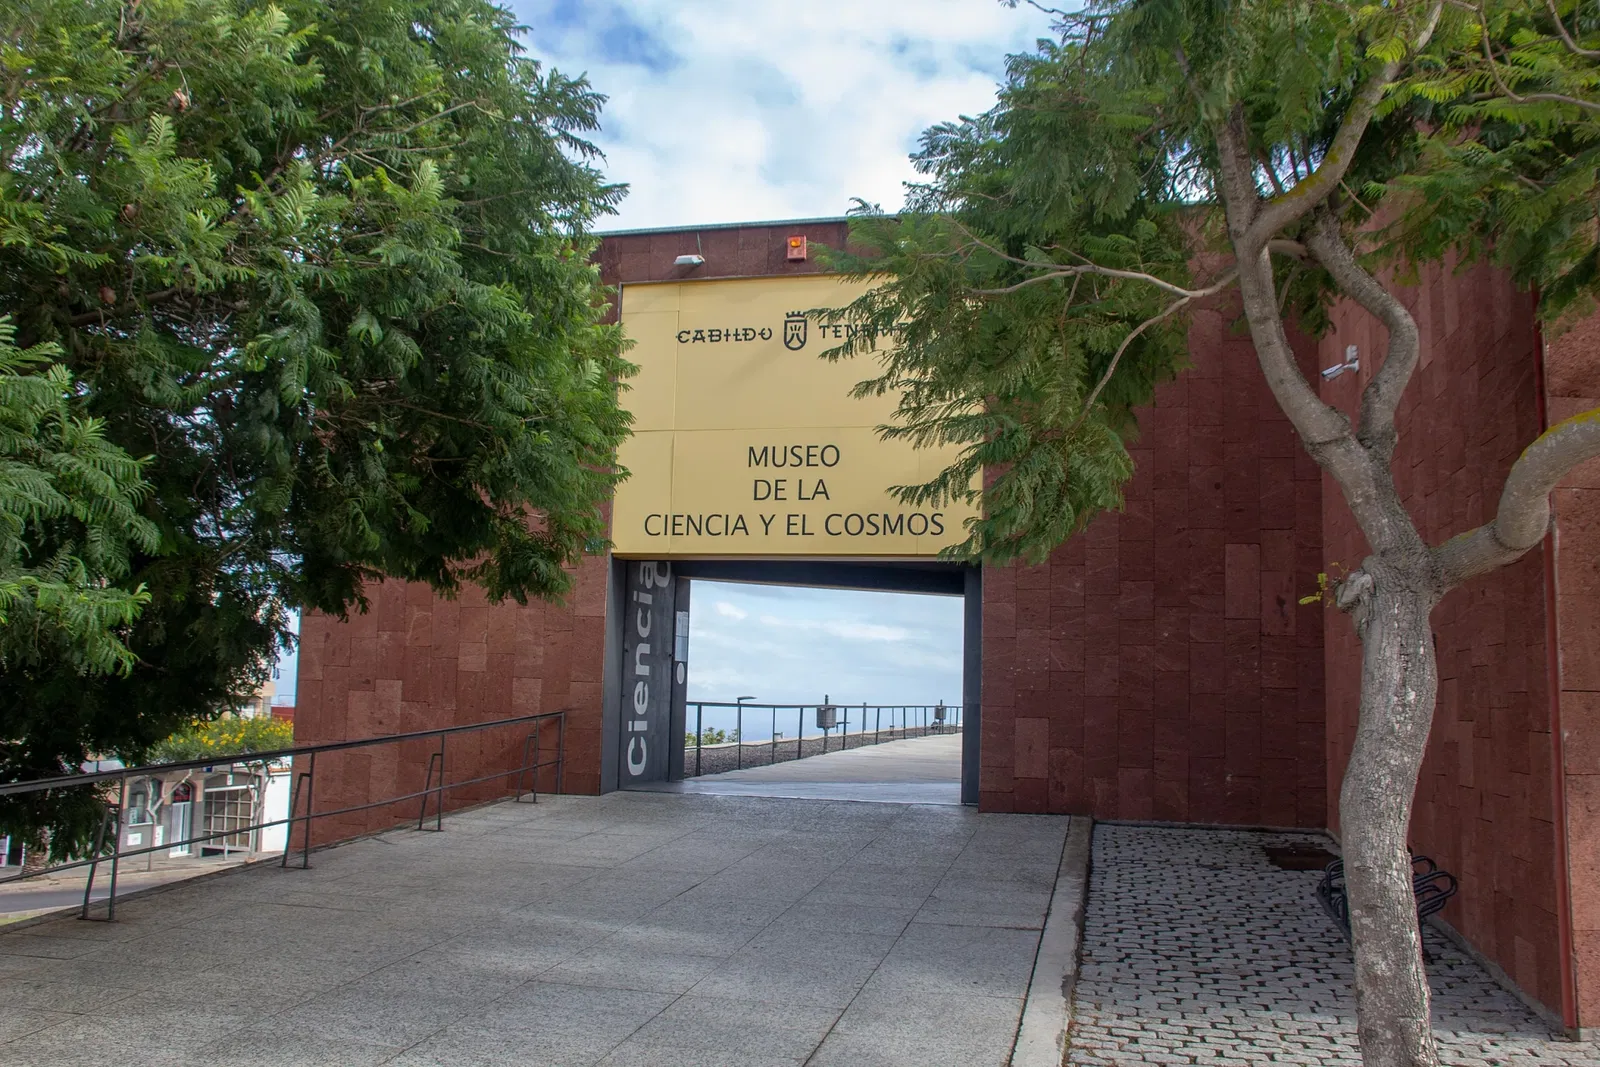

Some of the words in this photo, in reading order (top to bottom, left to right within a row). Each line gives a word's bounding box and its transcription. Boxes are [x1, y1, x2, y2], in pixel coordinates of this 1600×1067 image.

[676, 327, 773, 344] CABILDO
[748, 445, 840, 468] MUSEO
[753, 479, 787, 501] DE
[798, 479, 830, 501] LA
[644, 513, 750, 537] CIENCIA
[759, 513, 776, 536] Y
[786, 513, 815, 536] EL
[824, 513, 945, 537] COSMOS
[627, 561, 654, 777] Ciencia
